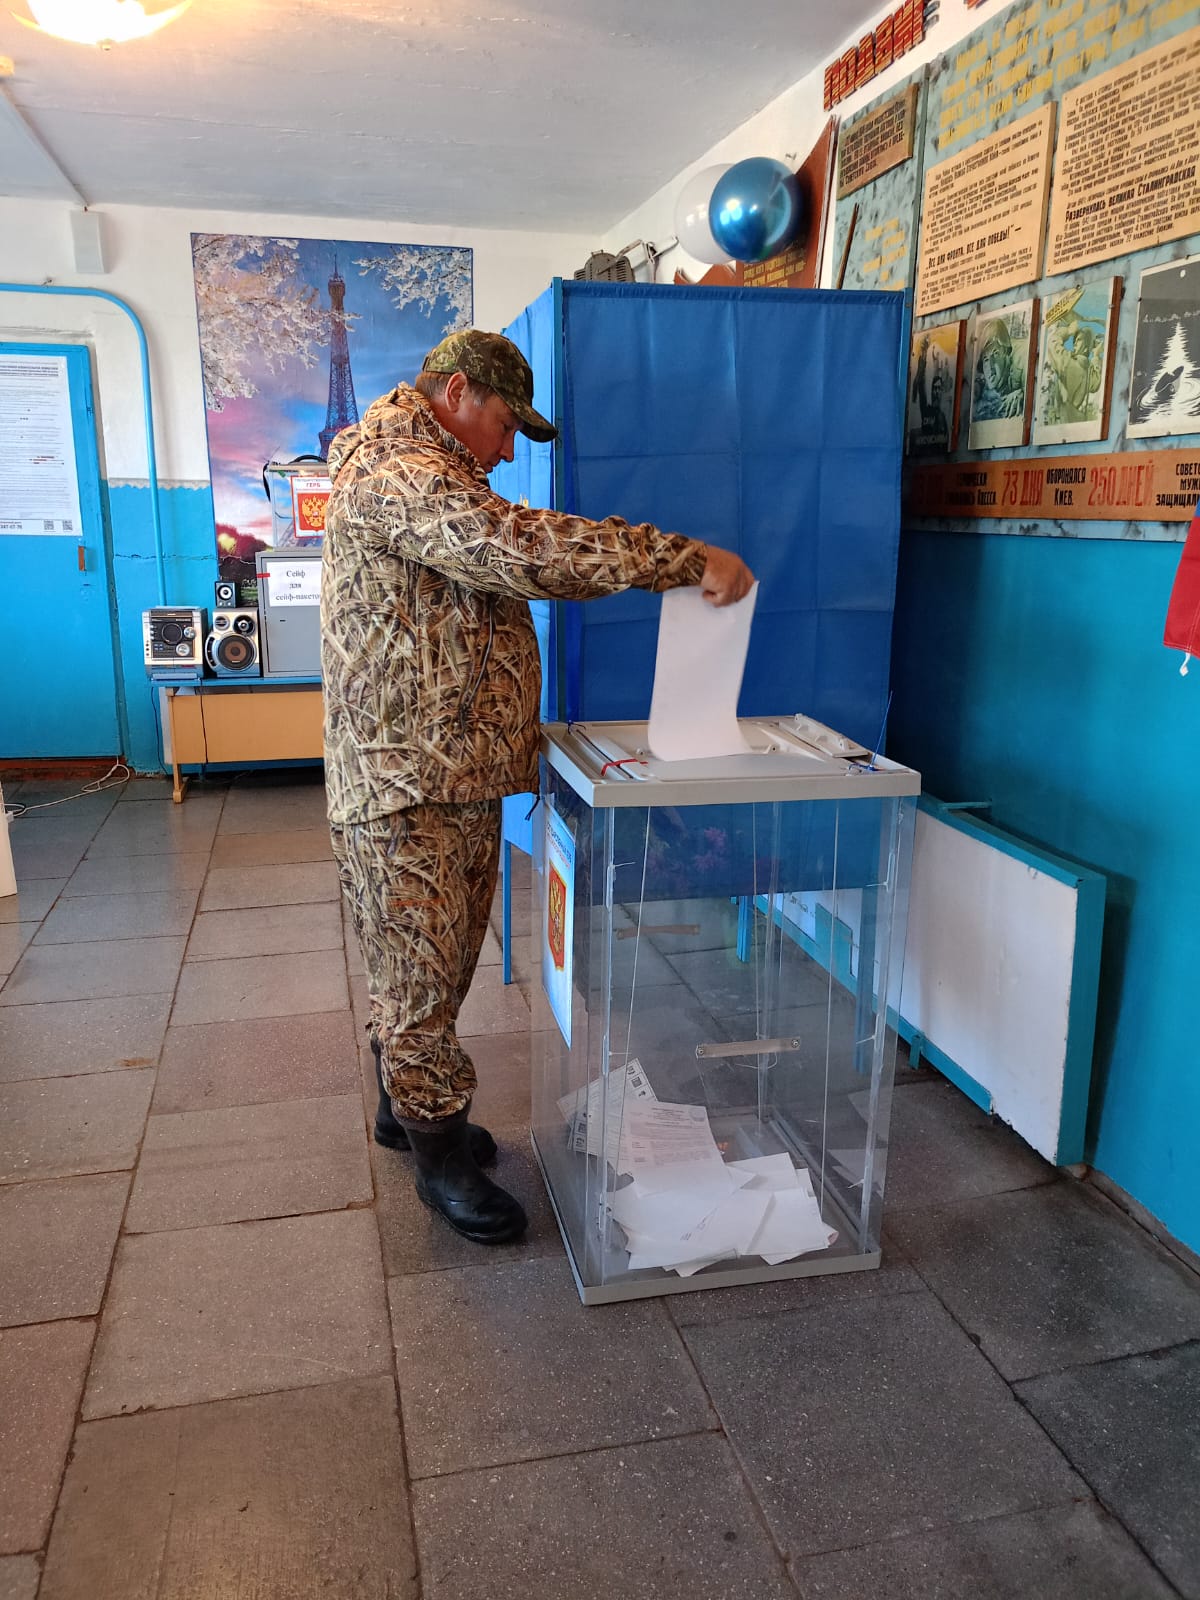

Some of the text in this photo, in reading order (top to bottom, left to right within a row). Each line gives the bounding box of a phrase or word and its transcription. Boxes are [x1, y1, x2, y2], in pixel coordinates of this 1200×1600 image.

[1001, 469, 1019, 506] 73
[1088, 466, 1117, 506] 250
[1180, 478, 1200, 491] МУЖ
[286, 569, 306, 578] Сейф
[275, 593, 321, 601] сейф-пакето
